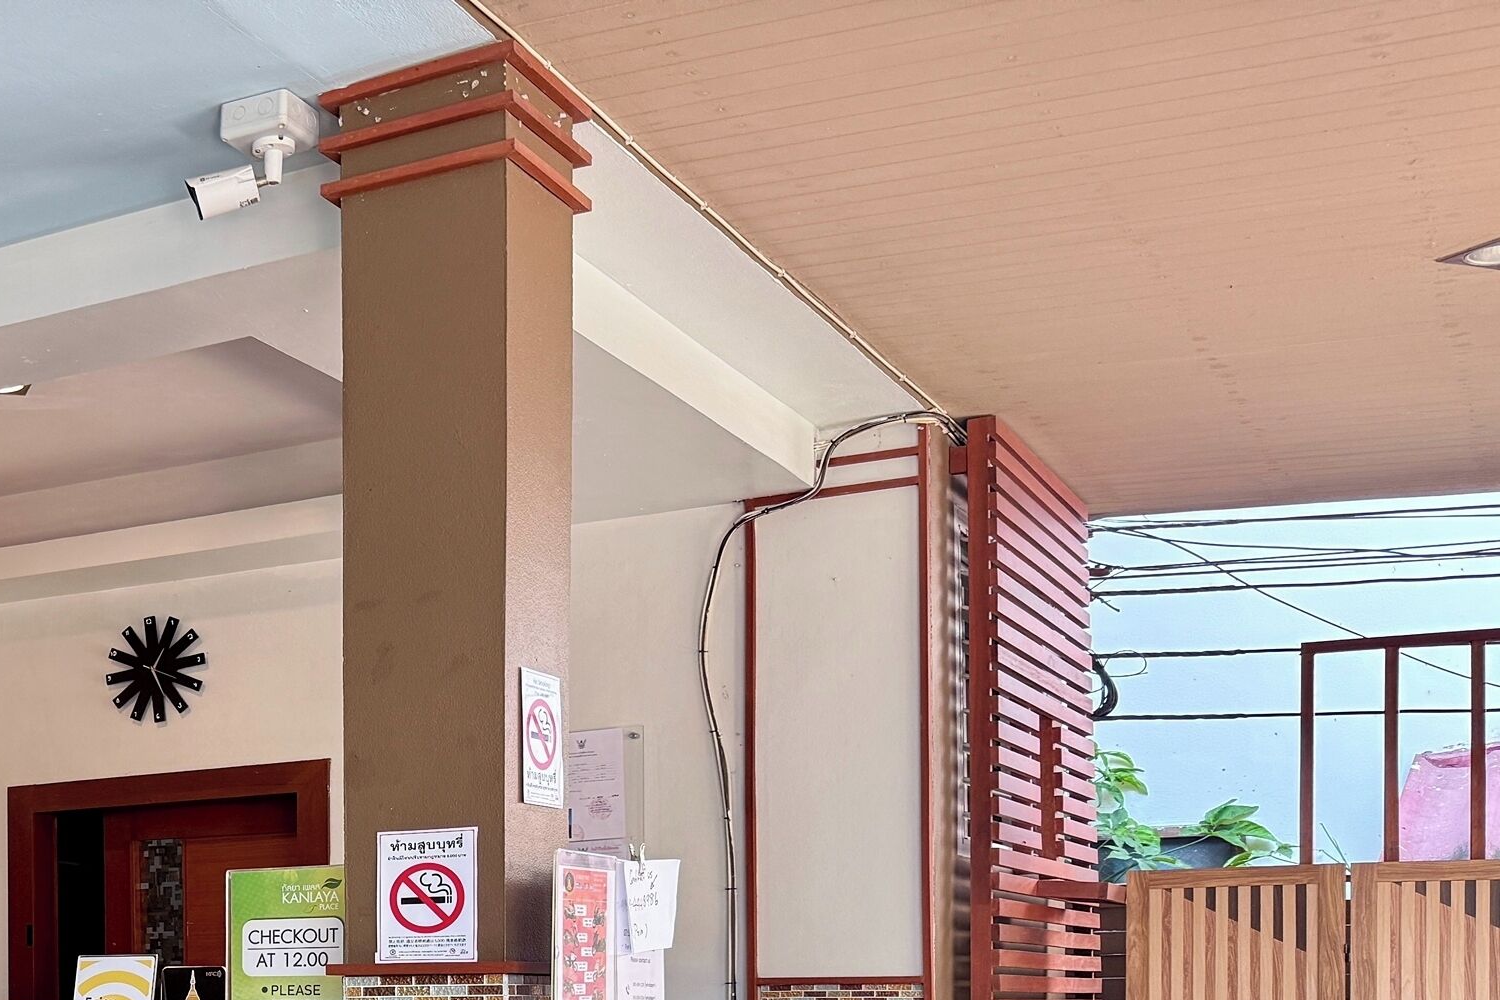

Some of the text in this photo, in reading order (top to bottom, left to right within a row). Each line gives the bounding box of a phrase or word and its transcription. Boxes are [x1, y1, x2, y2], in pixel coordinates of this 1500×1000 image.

[390, 833, 463, 854] ห้ามสูบบุหรี่
[282, 890, 340, 904] KANLAYA
[319, 903, 339, 911] PLACE
[248, 928, 339, 945] CHECKOUT
[256, 952, 329, 968] AT 12.00
[271, 984, 321, 996] PLEASE
